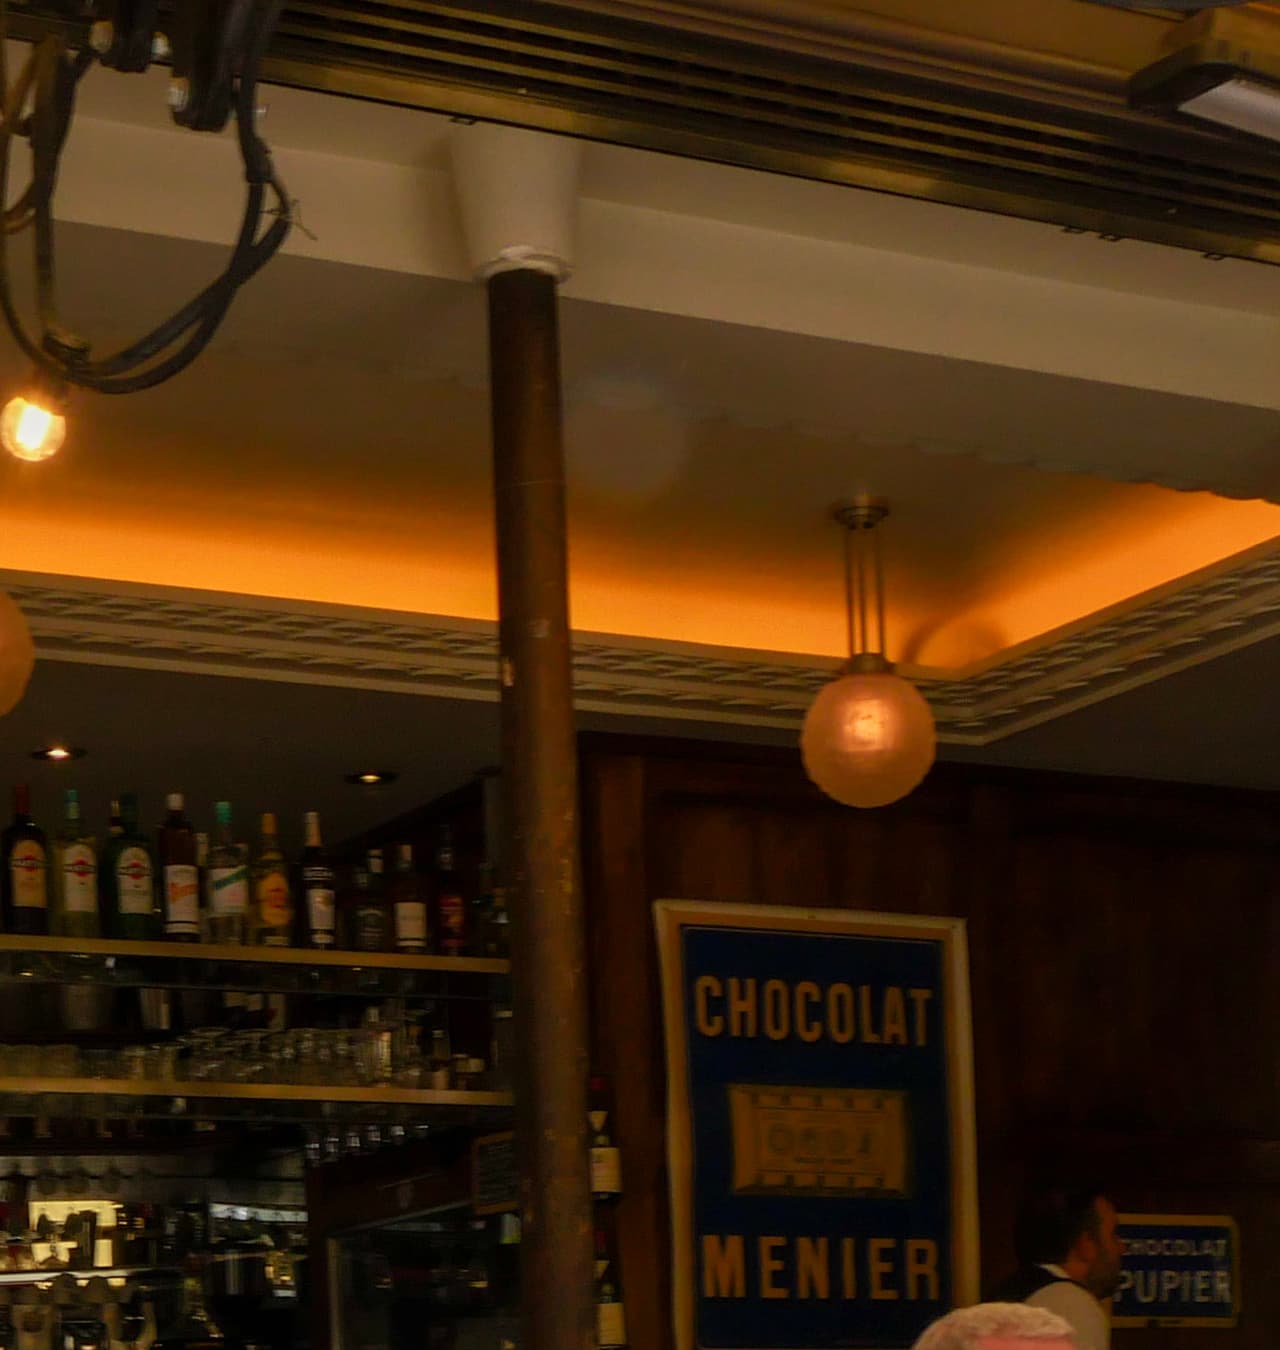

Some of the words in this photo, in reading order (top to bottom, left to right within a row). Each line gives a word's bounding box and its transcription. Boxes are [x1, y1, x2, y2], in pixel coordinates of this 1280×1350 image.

[694, 976, 932, 1047] CHOCOLAT
[701, 1234, 939, 1301] MENIER
[1112, 1270, 1231, 1304] PUPIER
